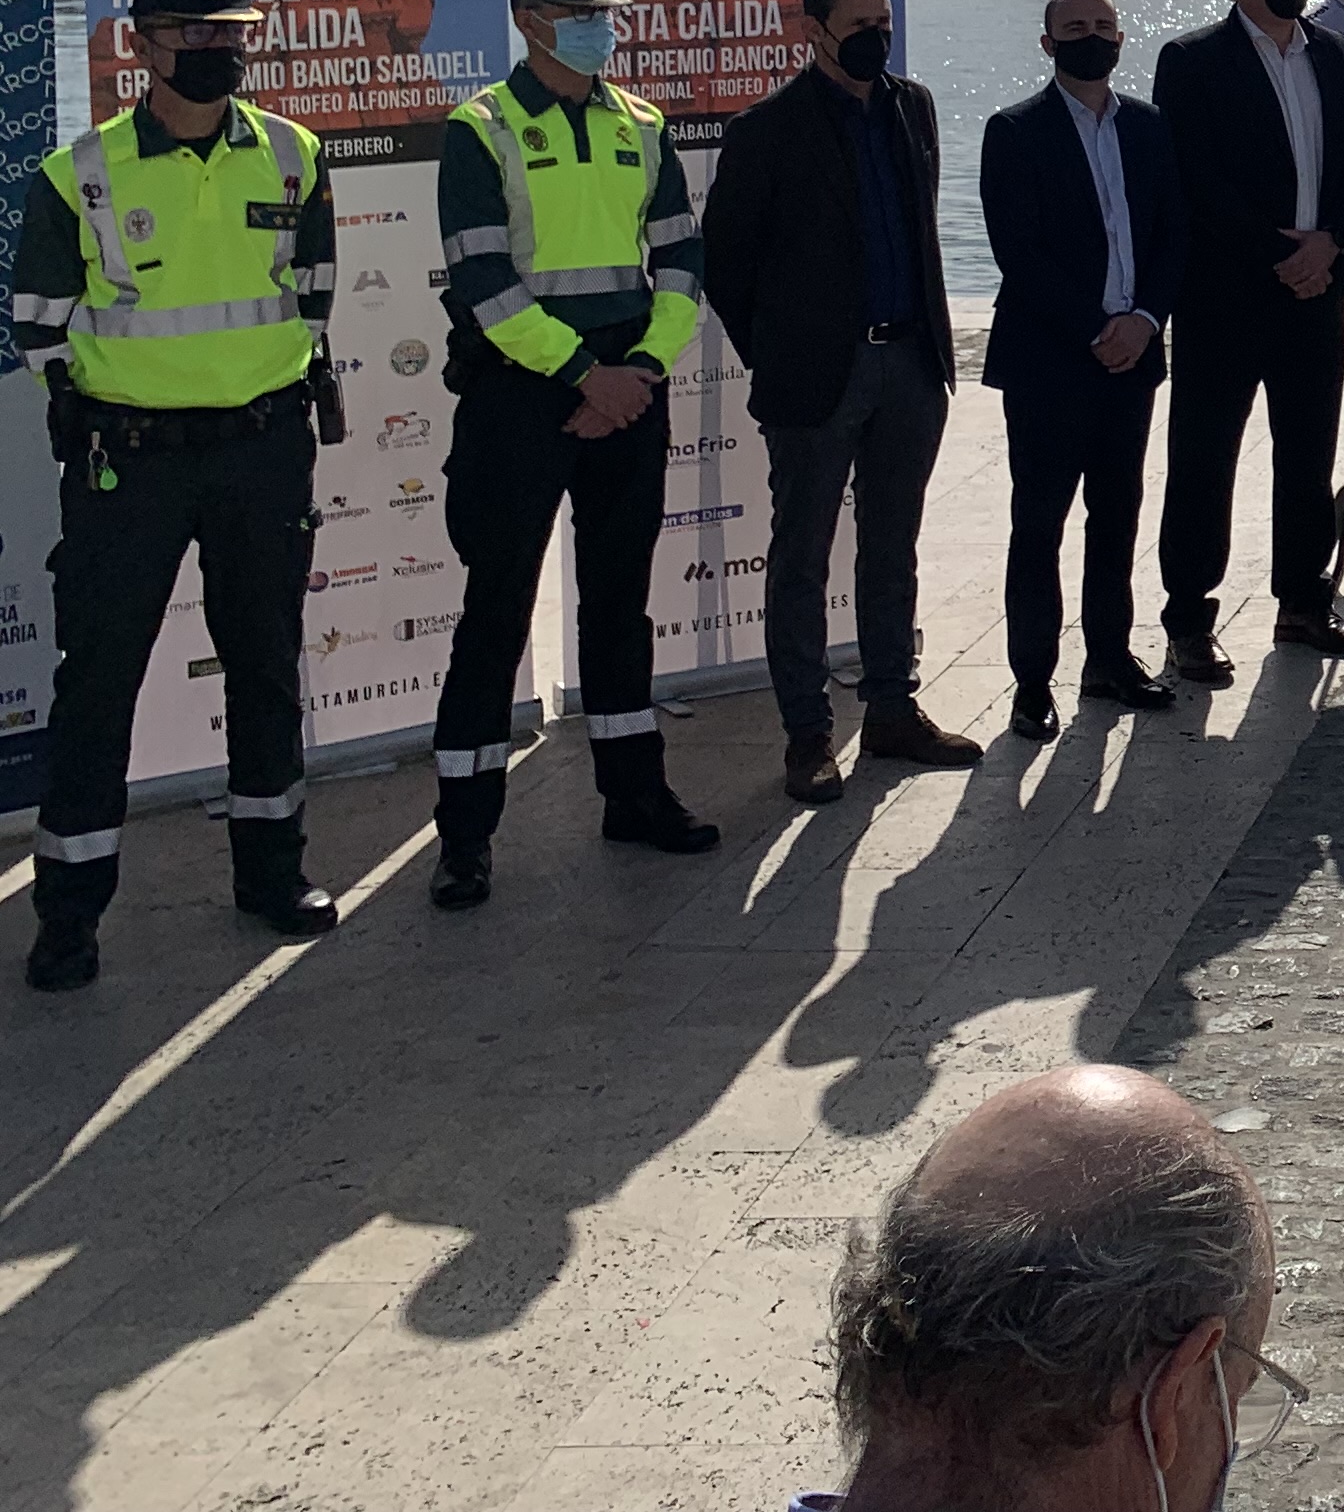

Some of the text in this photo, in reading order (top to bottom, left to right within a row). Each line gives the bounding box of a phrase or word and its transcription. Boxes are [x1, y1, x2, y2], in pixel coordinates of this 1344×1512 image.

[614, 3, 670, 43] STA
[292, 55, 371, 89] BANCO
[376, 50, 491, 84] SABADELL
[602, 51, 632, 79] AN
[637, 47, 715, 78] PREMIO
[720, 44, 787, 73] BANCO
[281, 81, 488, 115] TROFEO ALFONSO GUZMÁ
[709, 77, 763, 98] TROFEO
[668, 121, 723, 141] SÁBADO
[324, 137, 394, 159] FEBRERO
[703, 507, 733, 521] Dios
